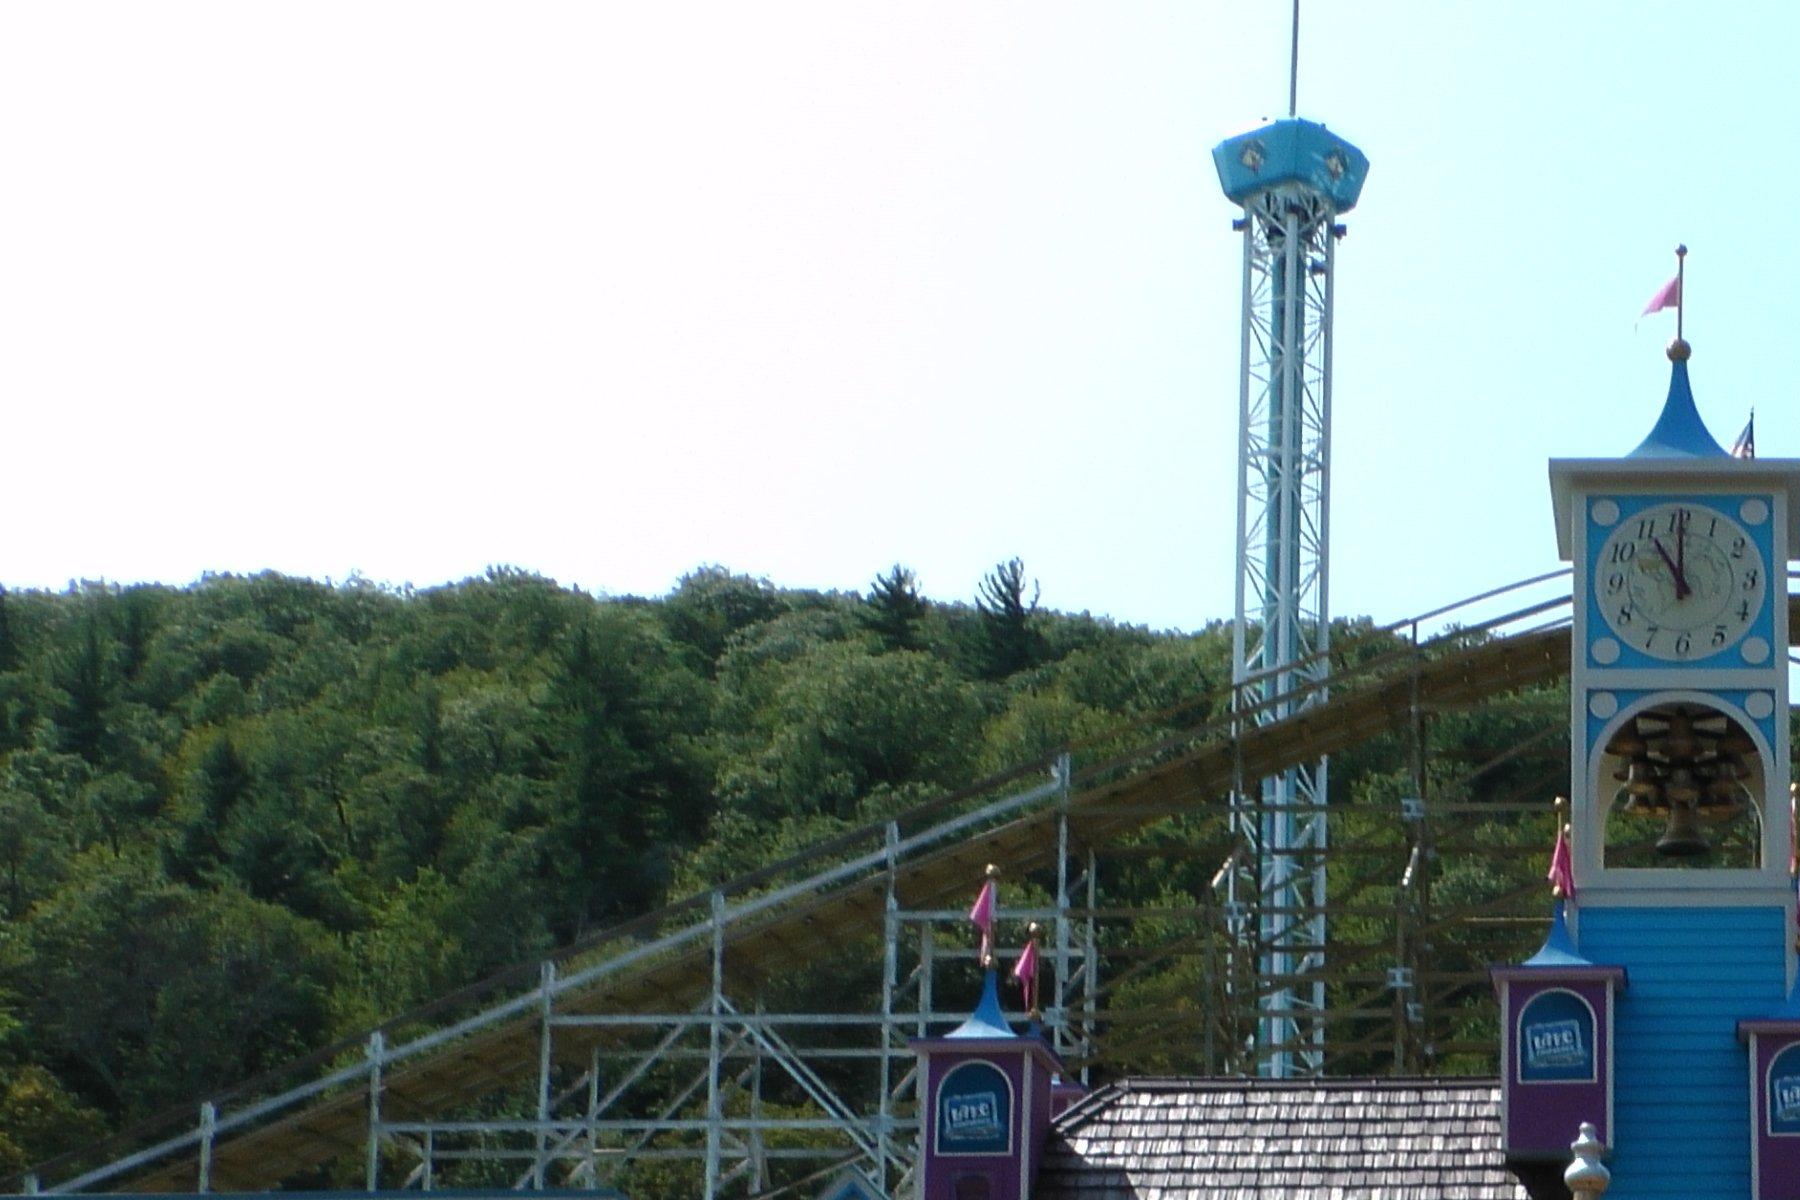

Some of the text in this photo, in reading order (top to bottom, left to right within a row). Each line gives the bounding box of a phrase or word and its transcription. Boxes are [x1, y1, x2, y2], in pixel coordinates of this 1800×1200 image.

[1638, 519, 1655, 539] 11
[1709, 518, 1717, 537] 1
[1611, 541, 1635, 563] 10
[1731, 537, 1746, 559] 2
[1608, 573, 1624, 596] 9
[1743, 569, 1757, 590] 3
[1617, 602, 1633, 626] 8
[1736, 599, 1749, 621] 4
[1645, 625, 1658, 649] 7
[1675, 631, 1692, 654] 6
[1712, 625, 1728, 647] 5
